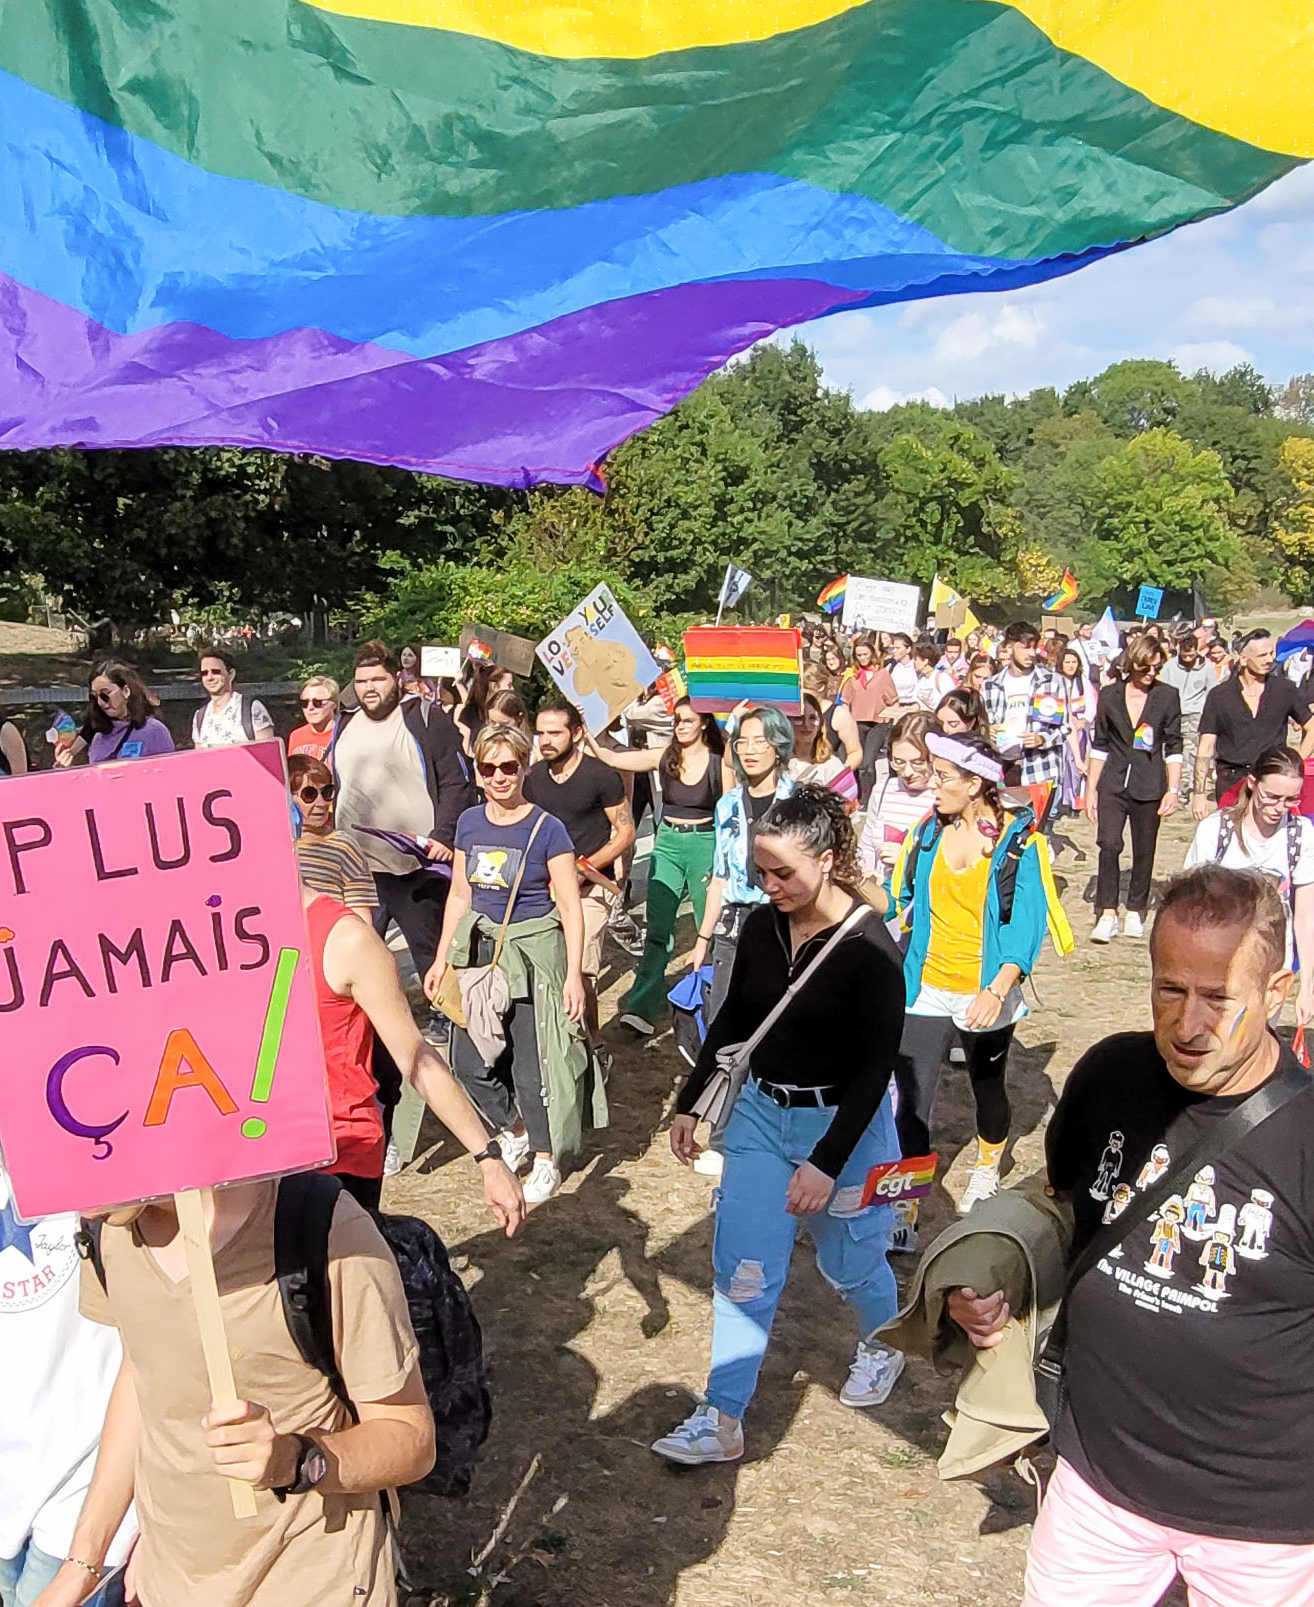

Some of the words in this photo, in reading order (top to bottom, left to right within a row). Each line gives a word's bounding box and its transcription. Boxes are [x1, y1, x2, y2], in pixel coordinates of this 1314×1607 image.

[589, 603, 615, 637] SELF
[2, 789, 242, 896] PLUS
[46, 946, 300, 1160] ÇA!
[875, 1171, 915, 1198] cgt
[35, 1233, 70, 1256] Taylor
[2, 1264, 56, 1299] STAR
[1114, 1266, 1161, 1296] VILLAGE
